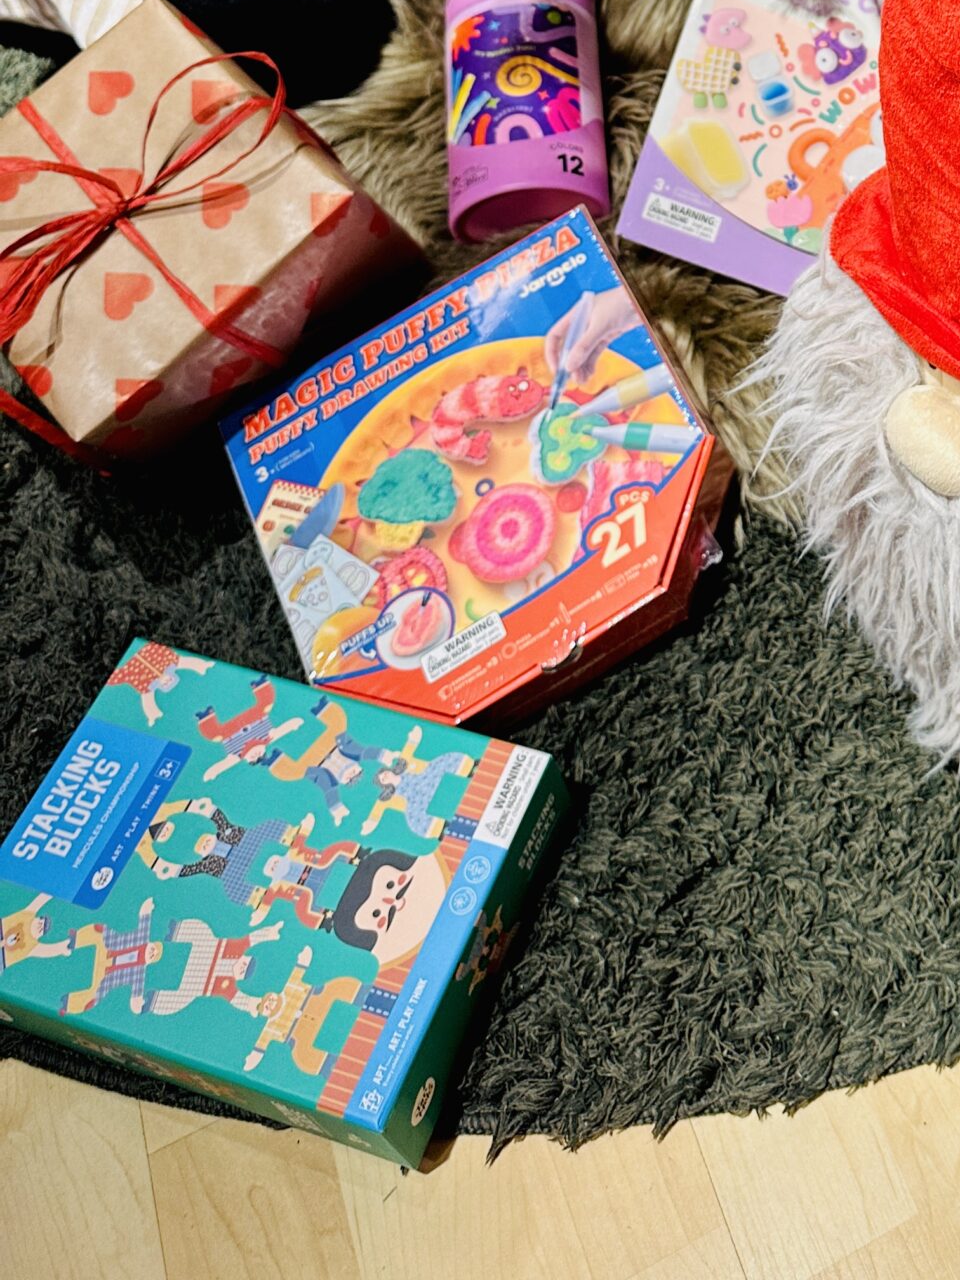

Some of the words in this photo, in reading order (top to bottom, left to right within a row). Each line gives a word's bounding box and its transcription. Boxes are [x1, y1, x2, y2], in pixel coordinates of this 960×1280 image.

[557, 153, 585, 177] 12
[242, 355, 357, 444] MAGIC
[360, 285, 470, 370] PUFFY
[473, 224, 581, 304] PIZZA
[248, 408, 319, 465] PUFFY
[320, 343, 429, 420] DRAWING
[430, 317, 471, 354] KIT
[590, 501, 647, 569] 27
[619, 490, 650, 507] PCS
[340, 623, 377, 653] PUFFS
[377, 612, 395, 632] UP
[12, 739, 104, 861] STACKING
[43, 758, 121, 858] BLOCKS
[159, 761, 175, 779] 3+
[72, 823, 104, 869] HERCULES
[101, 761, 140, 825] CHAMPIONSHIP
[111, 843, 124, 862] ART
[124, 816, 142, 839] PLAY
[141, 784, 161, 810] THINK
[518, 792, 555, 870] STACKING
[526, 807, 556, 871] BLOCKS
[388, 1031, 402, 1052] ART
[398, 1005, 415, 1030] PLAY
[409, 977, 429, 1005] THINK
